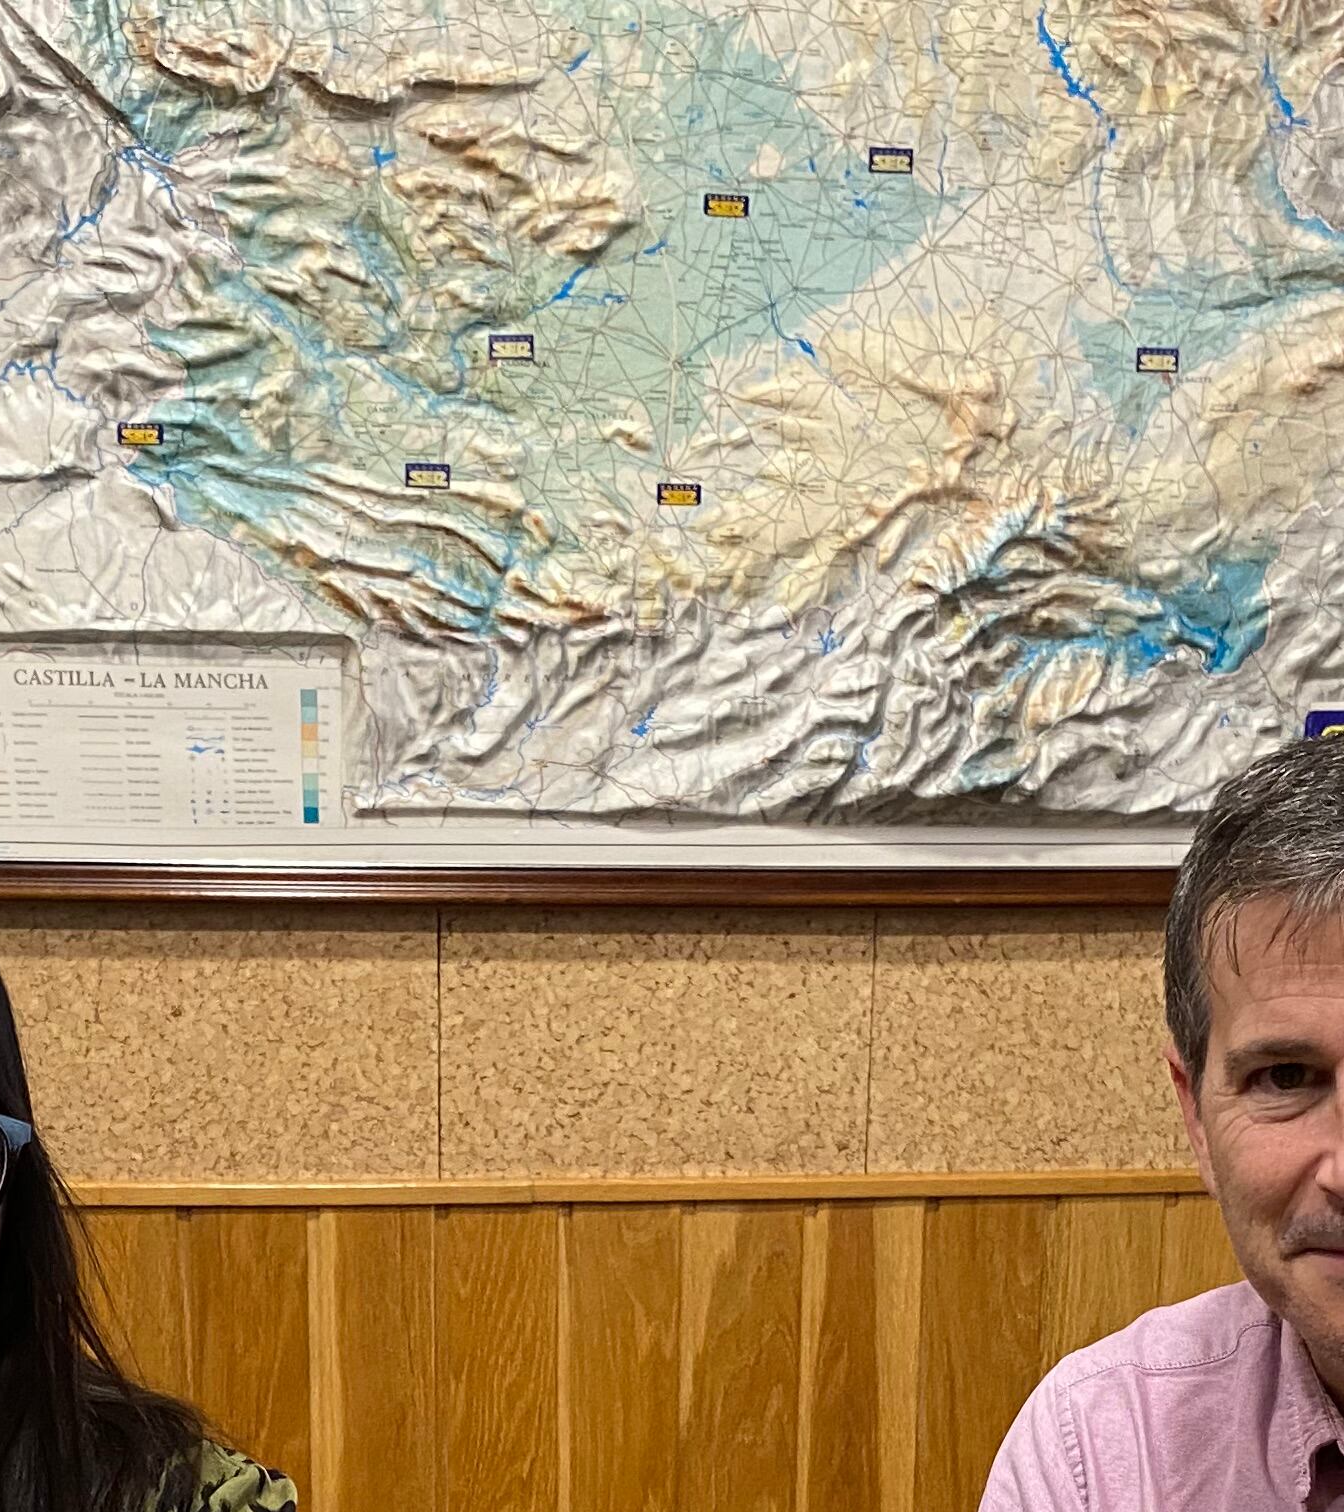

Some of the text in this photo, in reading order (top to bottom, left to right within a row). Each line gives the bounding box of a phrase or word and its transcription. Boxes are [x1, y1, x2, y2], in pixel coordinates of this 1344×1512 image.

[13, 668, 116, 688] CASTILLA
[140, 673, 167, 689] LA
[174, 674, 269, 690] MANCHA
